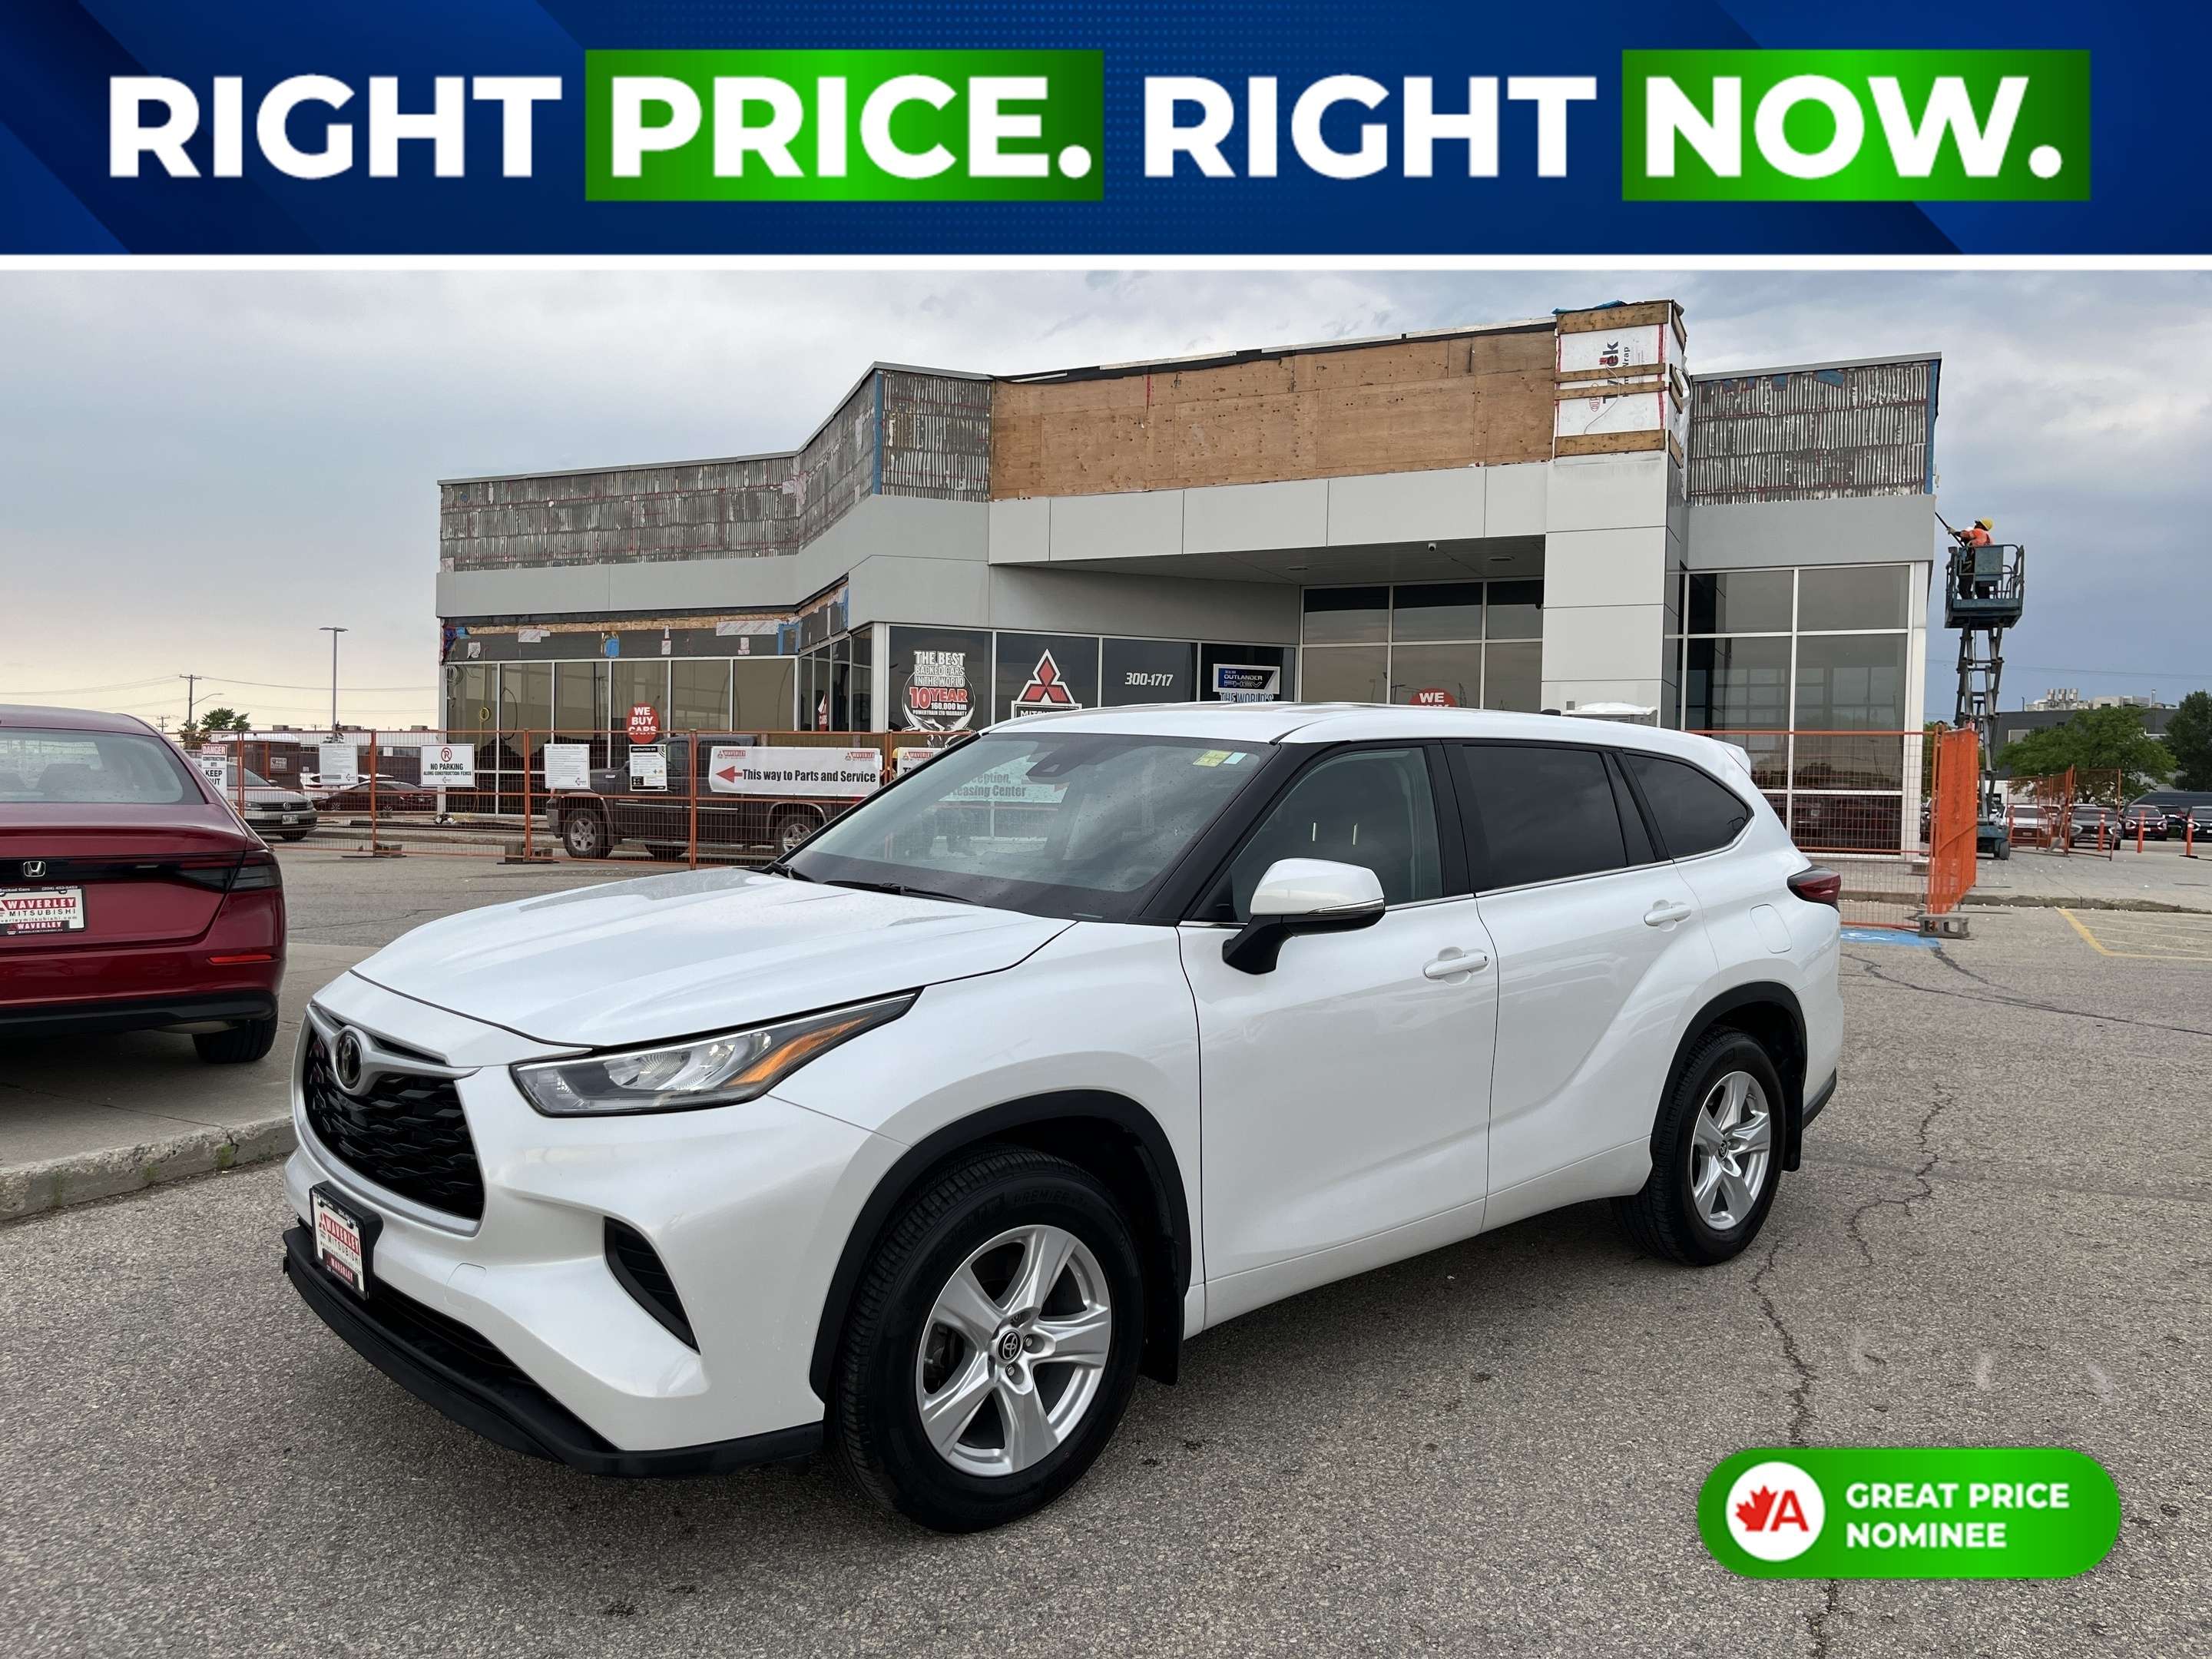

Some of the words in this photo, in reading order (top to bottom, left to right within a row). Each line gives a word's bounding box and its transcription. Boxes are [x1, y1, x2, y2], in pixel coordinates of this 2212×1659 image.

[914, 651, 935, 665] THE
[937, 651, 965, 667] BEST
[915, 665, 945, 675] BACKED
[945, 666, 965, 676] CARS
[915, 676, 923, 686] IN
[924, 677, 938, 686] THE
[939, 677, 965, 687] WORLD
[1124, 672, 1174, 687] 300-1717
[909, 687, 932, 709] 10
[929, 687, 969, 703] YEAR
[1220, 692, 1237, 703] THE
[1237, 693, 1274, 703] WORLD'S
[1419, 692, 1445, 704] WE
[634, 707, 651, 716] WE
[631, 716, 654, 726] BUY
[628, 726, 657, 735] CARS
[203, 746, 226, 755] DANGER
[743, 769, 762, 780] This
[763, 771, 781, 782] way
[783, 770, 793, 780] to
[795, 770, 819, 781] Parts
[821, 770, 839, 782] and
[840, 770, 876, 783] Service
[992, 785, 1027, 797] Center
[7, 898, 75, 909] WAVERLEY
[9, 909, 76, 917] MITSUBISHI
[17, 922, 61, 930] WAVERLEY
